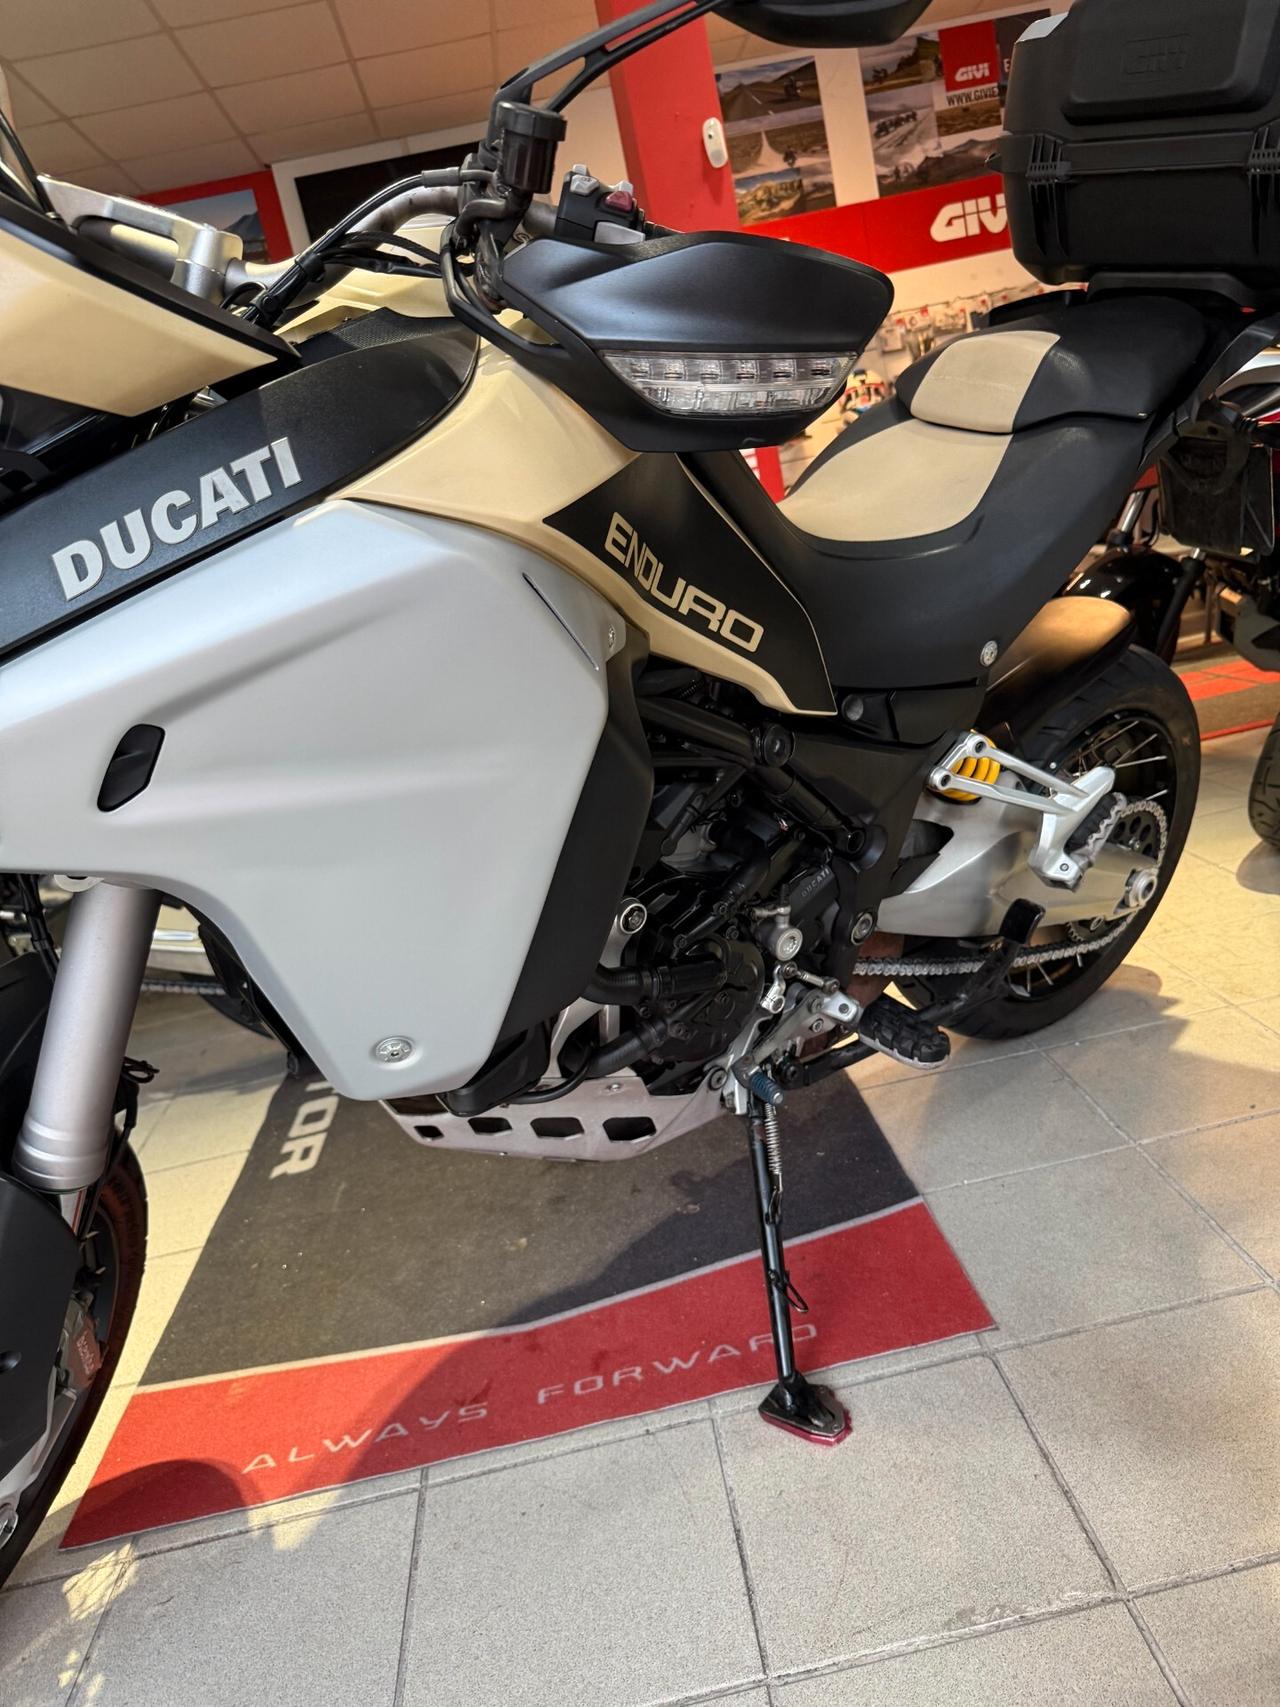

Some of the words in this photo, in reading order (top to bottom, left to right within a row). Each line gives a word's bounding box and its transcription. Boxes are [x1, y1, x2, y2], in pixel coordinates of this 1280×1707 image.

[954, 62, 990, 82] GIVI
[52, 436, 302, 601] DUCATI
[604, 511, 765, 653] ENDURO
[241, 1401, 488, 1474] ALWAYS
[537, 1323, 818, 1405] FORWARD
